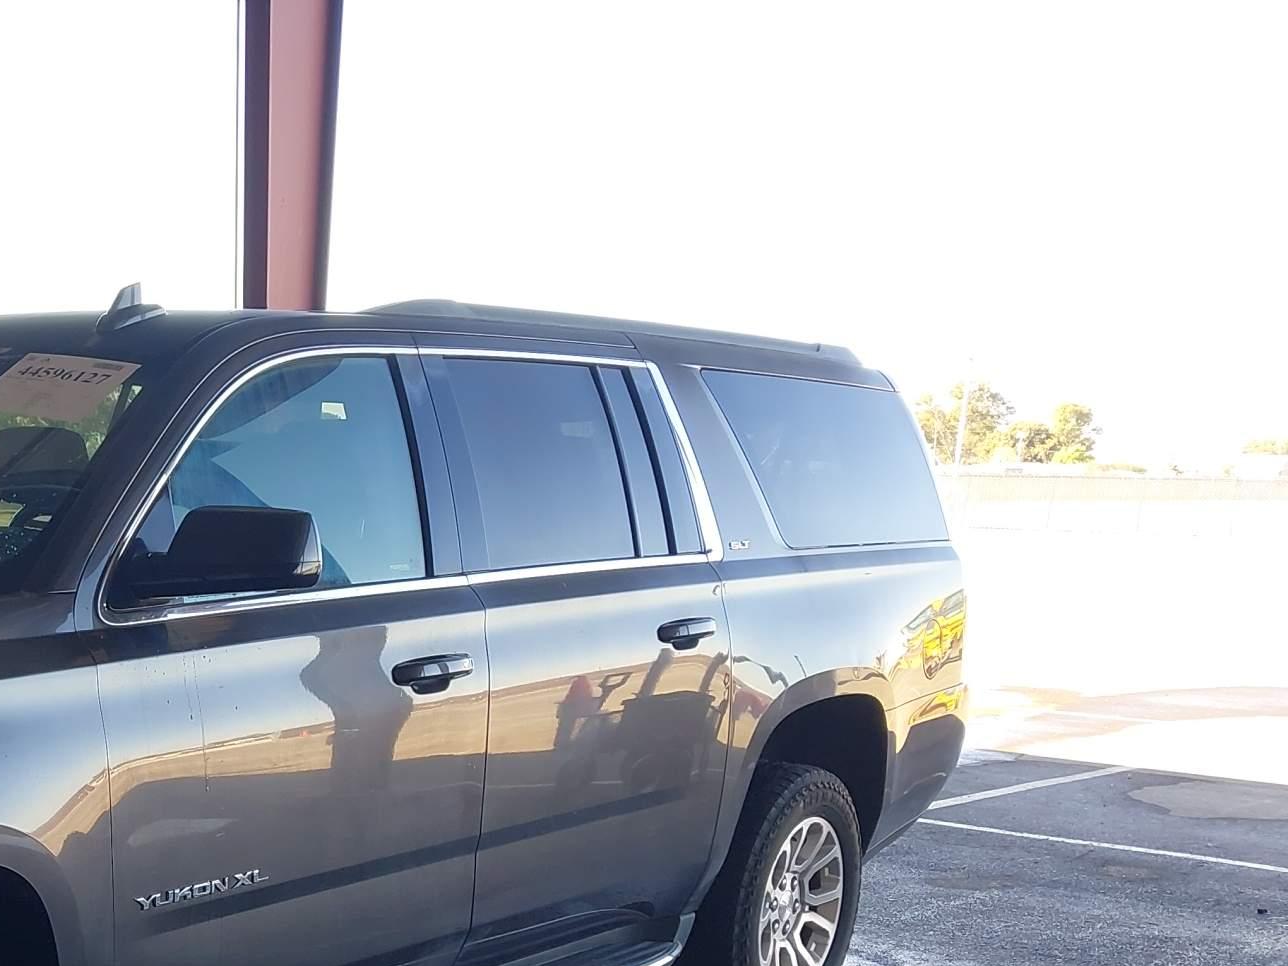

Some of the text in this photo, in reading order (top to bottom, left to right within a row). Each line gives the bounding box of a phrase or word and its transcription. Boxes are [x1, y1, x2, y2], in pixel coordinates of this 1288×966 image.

[17, 366, 112, 385] 44596127
[135, 869, 270, 911] YUKON XL
